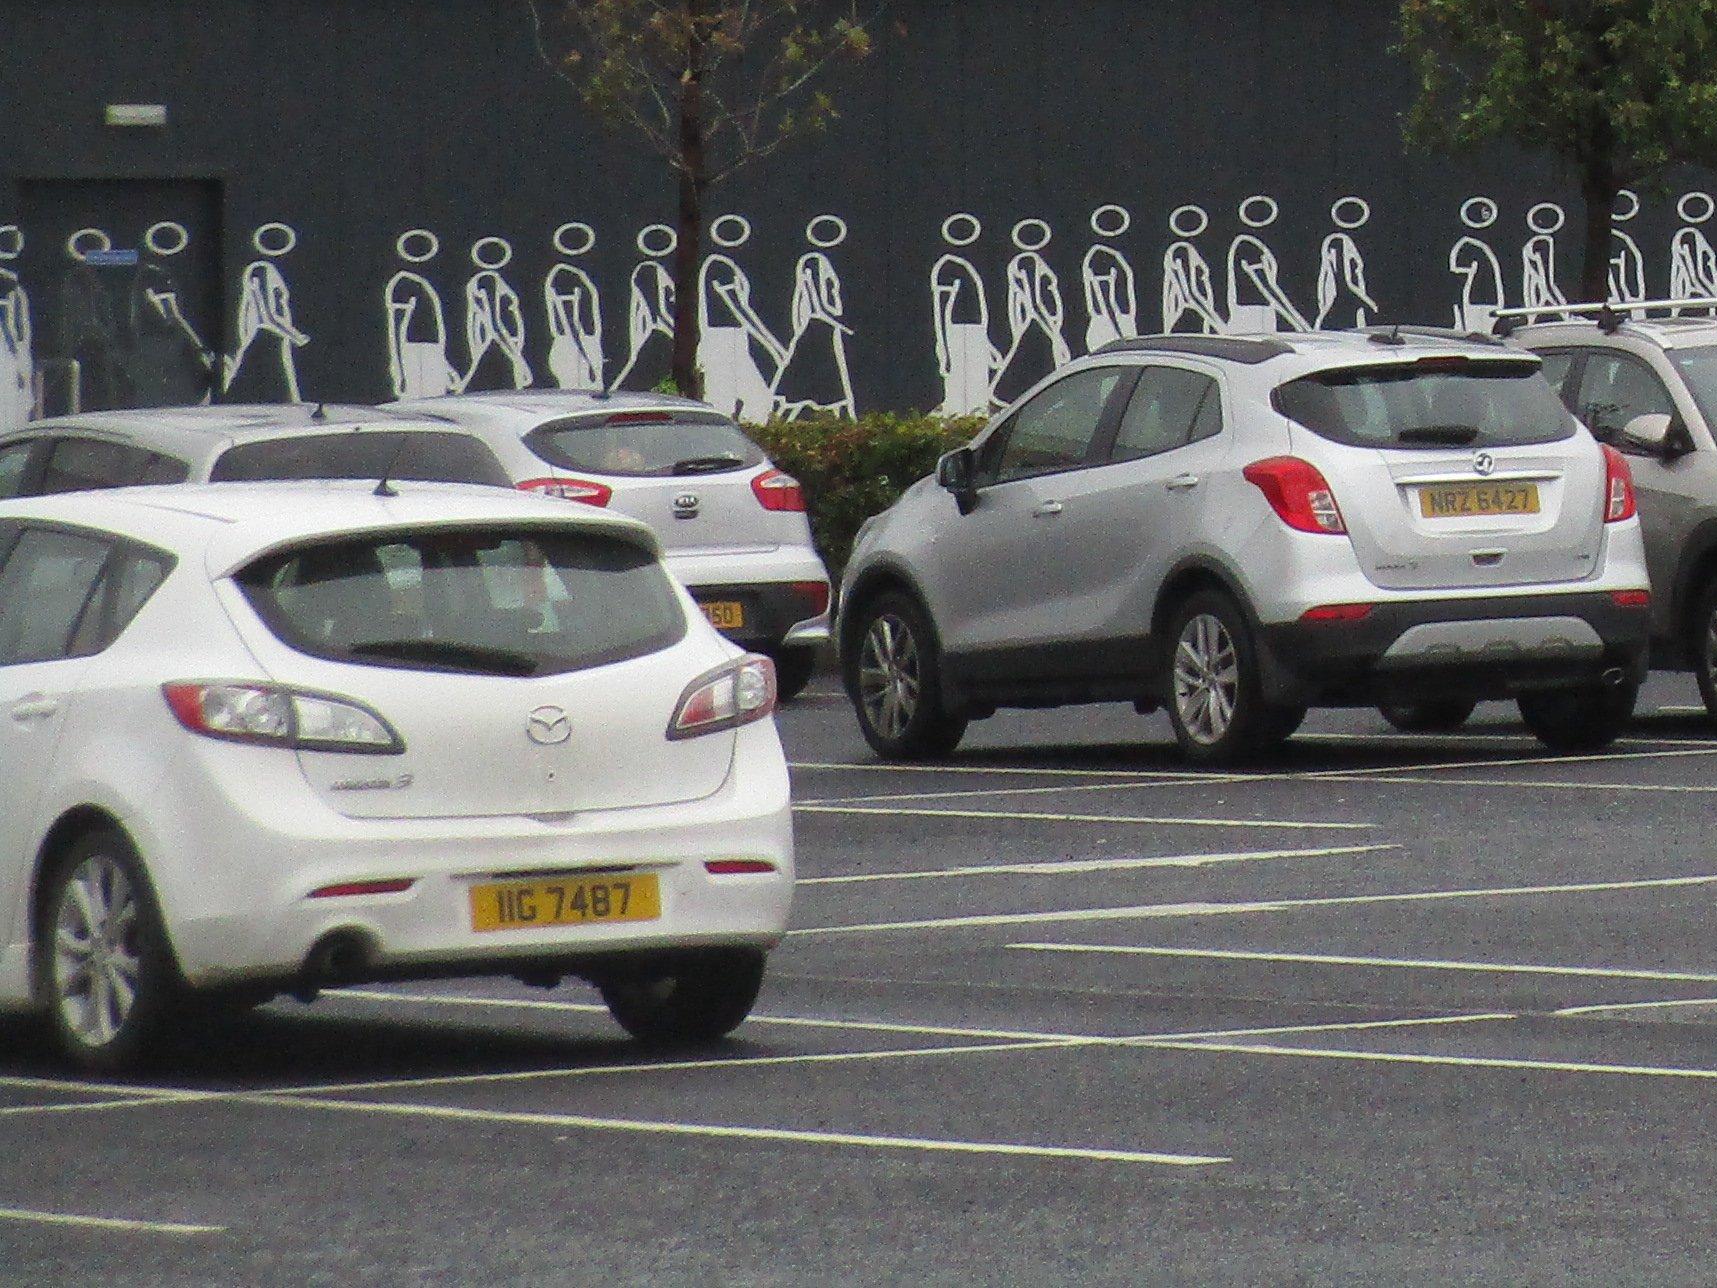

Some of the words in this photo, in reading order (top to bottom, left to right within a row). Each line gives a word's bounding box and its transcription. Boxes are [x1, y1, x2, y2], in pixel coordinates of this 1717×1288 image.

[1430, 490, 1471, 513] NRZ
[1476, 488, 1529, 510] 6427
[545, 882, 631, 920] 7487
